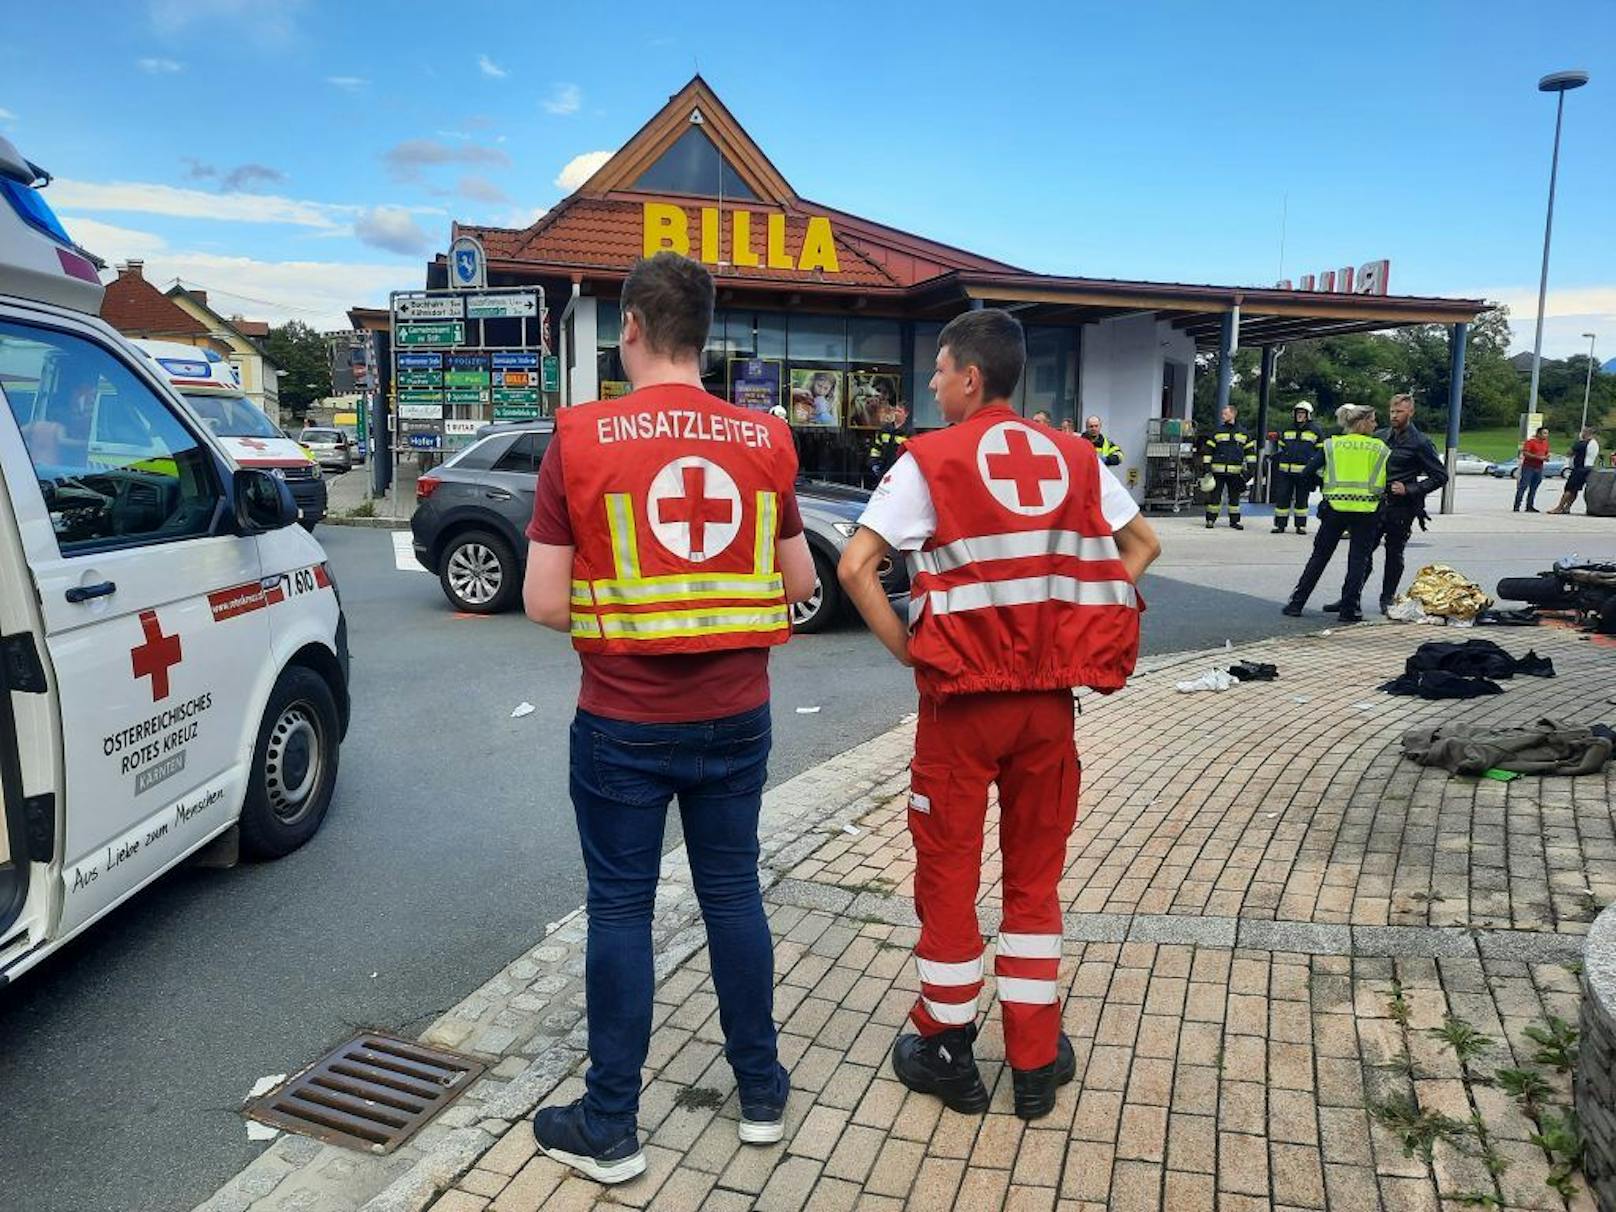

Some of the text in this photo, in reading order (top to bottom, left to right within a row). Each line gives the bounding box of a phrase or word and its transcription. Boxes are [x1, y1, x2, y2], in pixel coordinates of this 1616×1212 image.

[643, 202, 840, 272] BILLA
[597, 410, 772, 449] EINSATZLEITER
[103, 692, 212, 756] ÖSTERREICHISCHES
[122, 721, 198, 775] ROTES KREUZ
[72, 789, 224, 894] Aus Liebe zum Menschen
